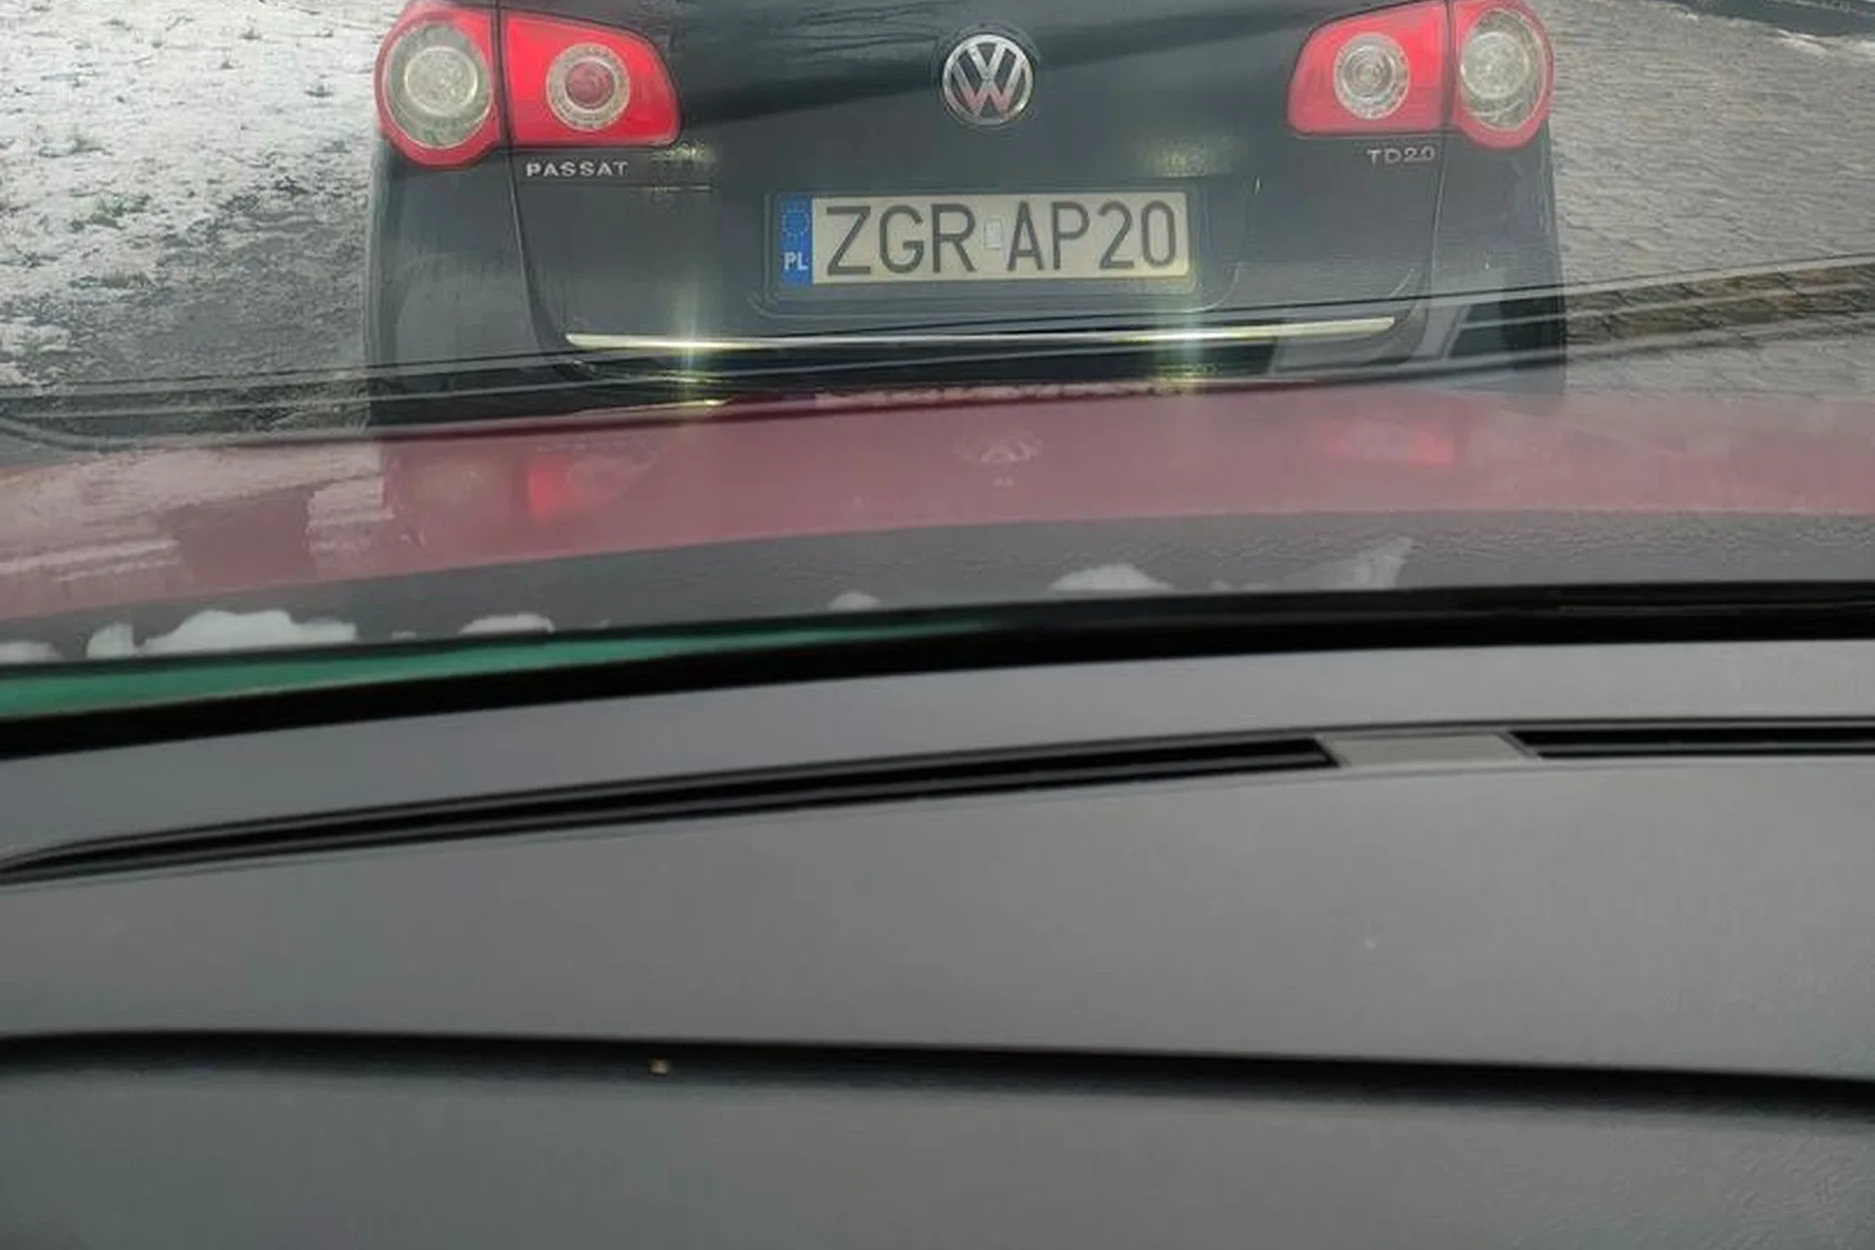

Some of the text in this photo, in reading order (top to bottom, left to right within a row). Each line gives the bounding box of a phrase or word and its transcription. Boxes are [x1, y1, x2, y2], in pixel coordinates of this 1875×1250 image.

[525, 161, 629, 177] PASSAT
[826, 199, 1176, 276] ZGR AP20
[784, 251, 809, 270] PL
